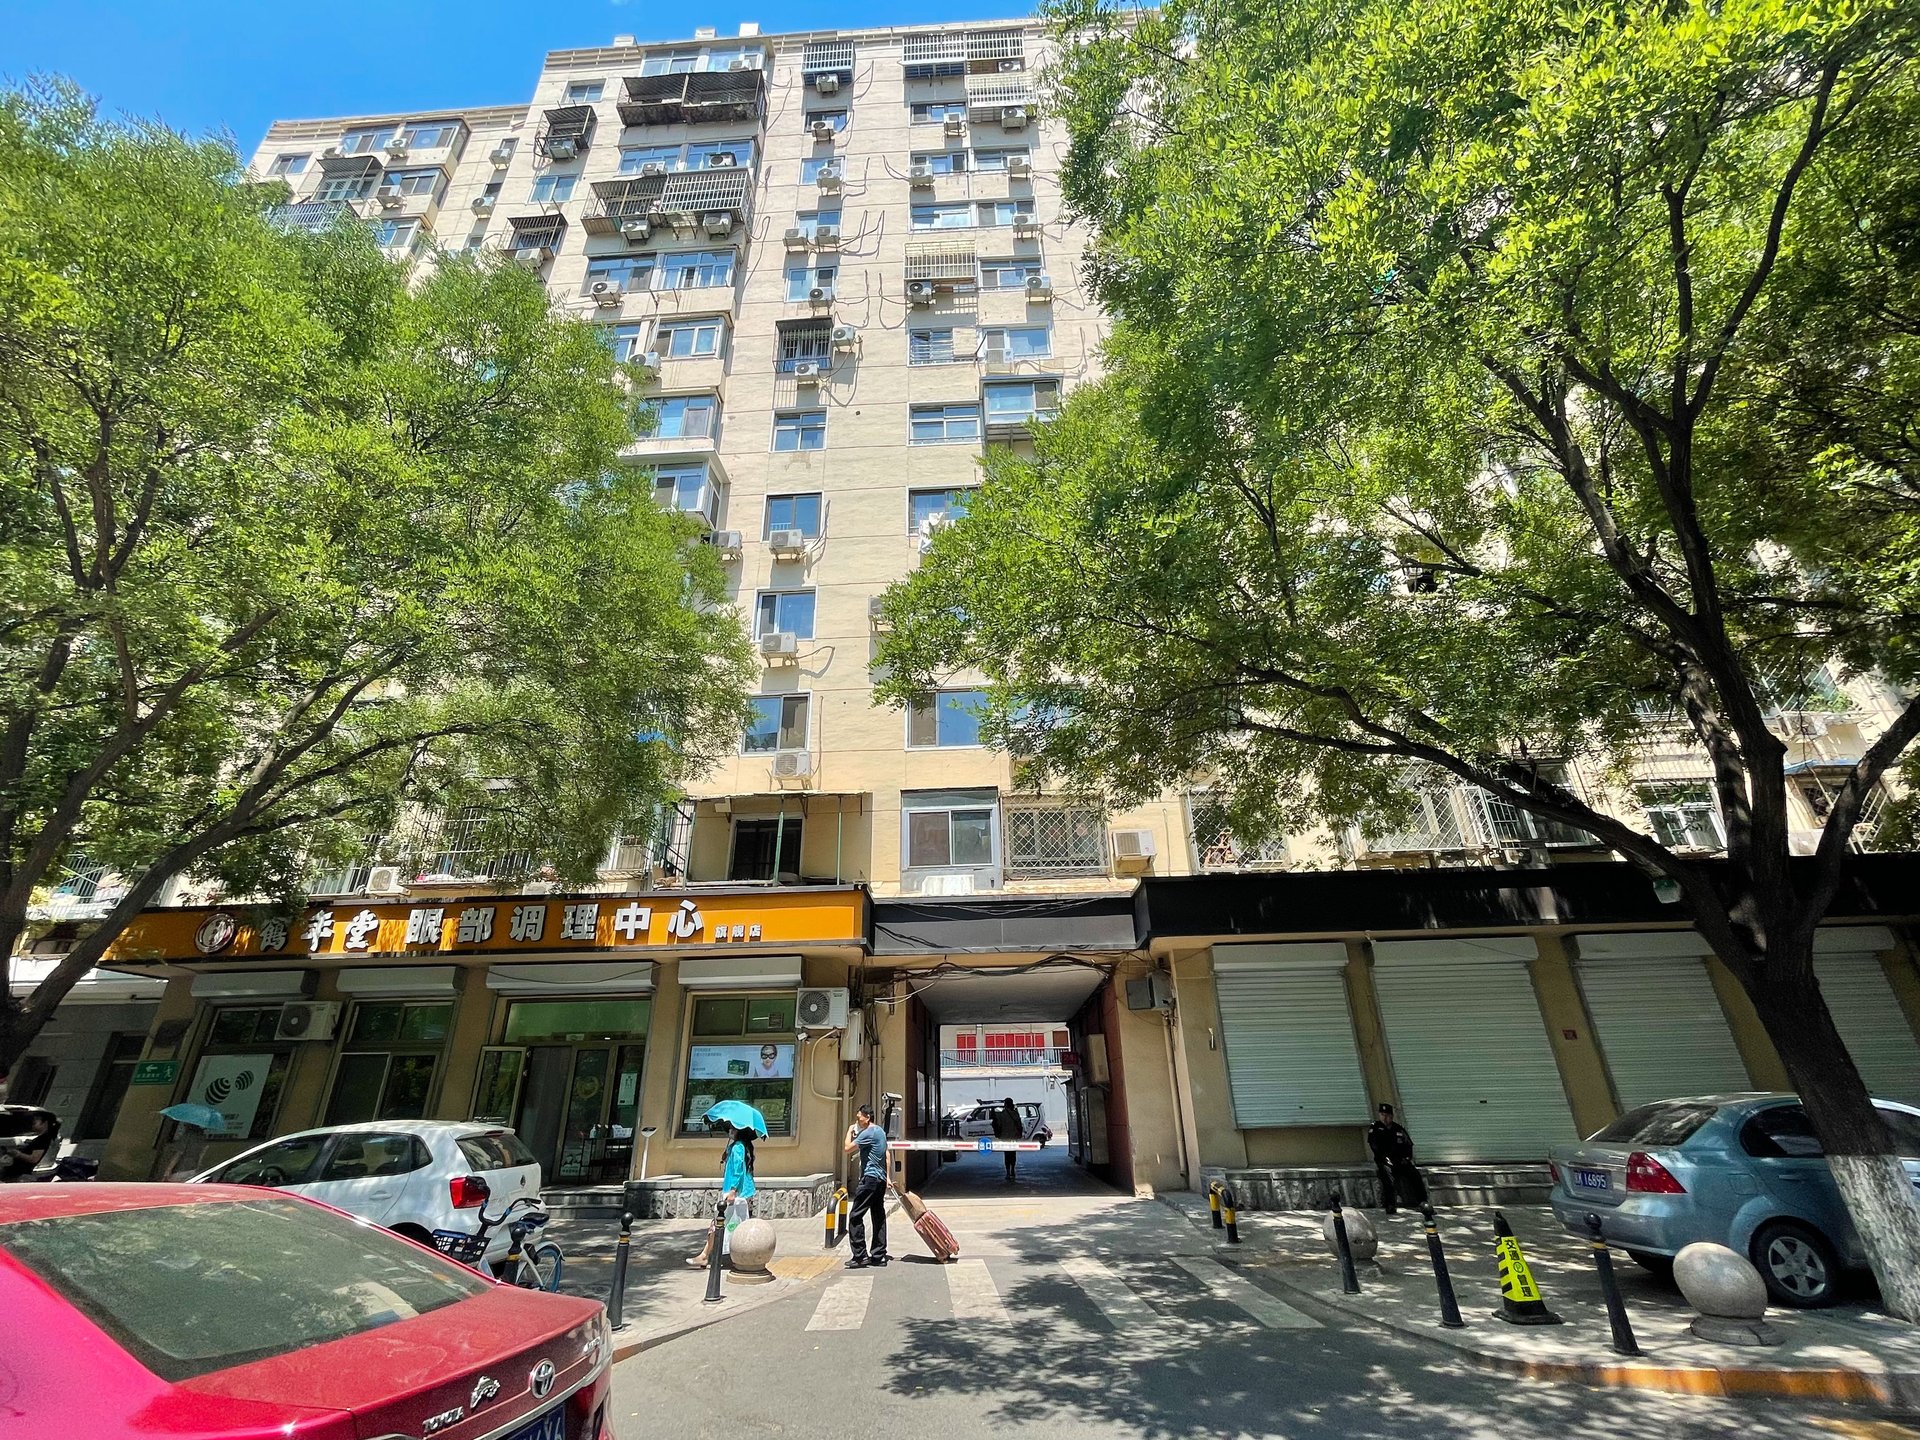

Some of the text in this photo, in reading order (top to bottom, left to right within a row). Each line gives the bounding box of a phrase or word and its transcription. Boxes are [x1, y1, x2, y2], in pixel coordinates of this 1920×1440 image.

[715, 924, 761, 938] 旗舰店
[422, 1406, 464, 1433] TOYOTA
